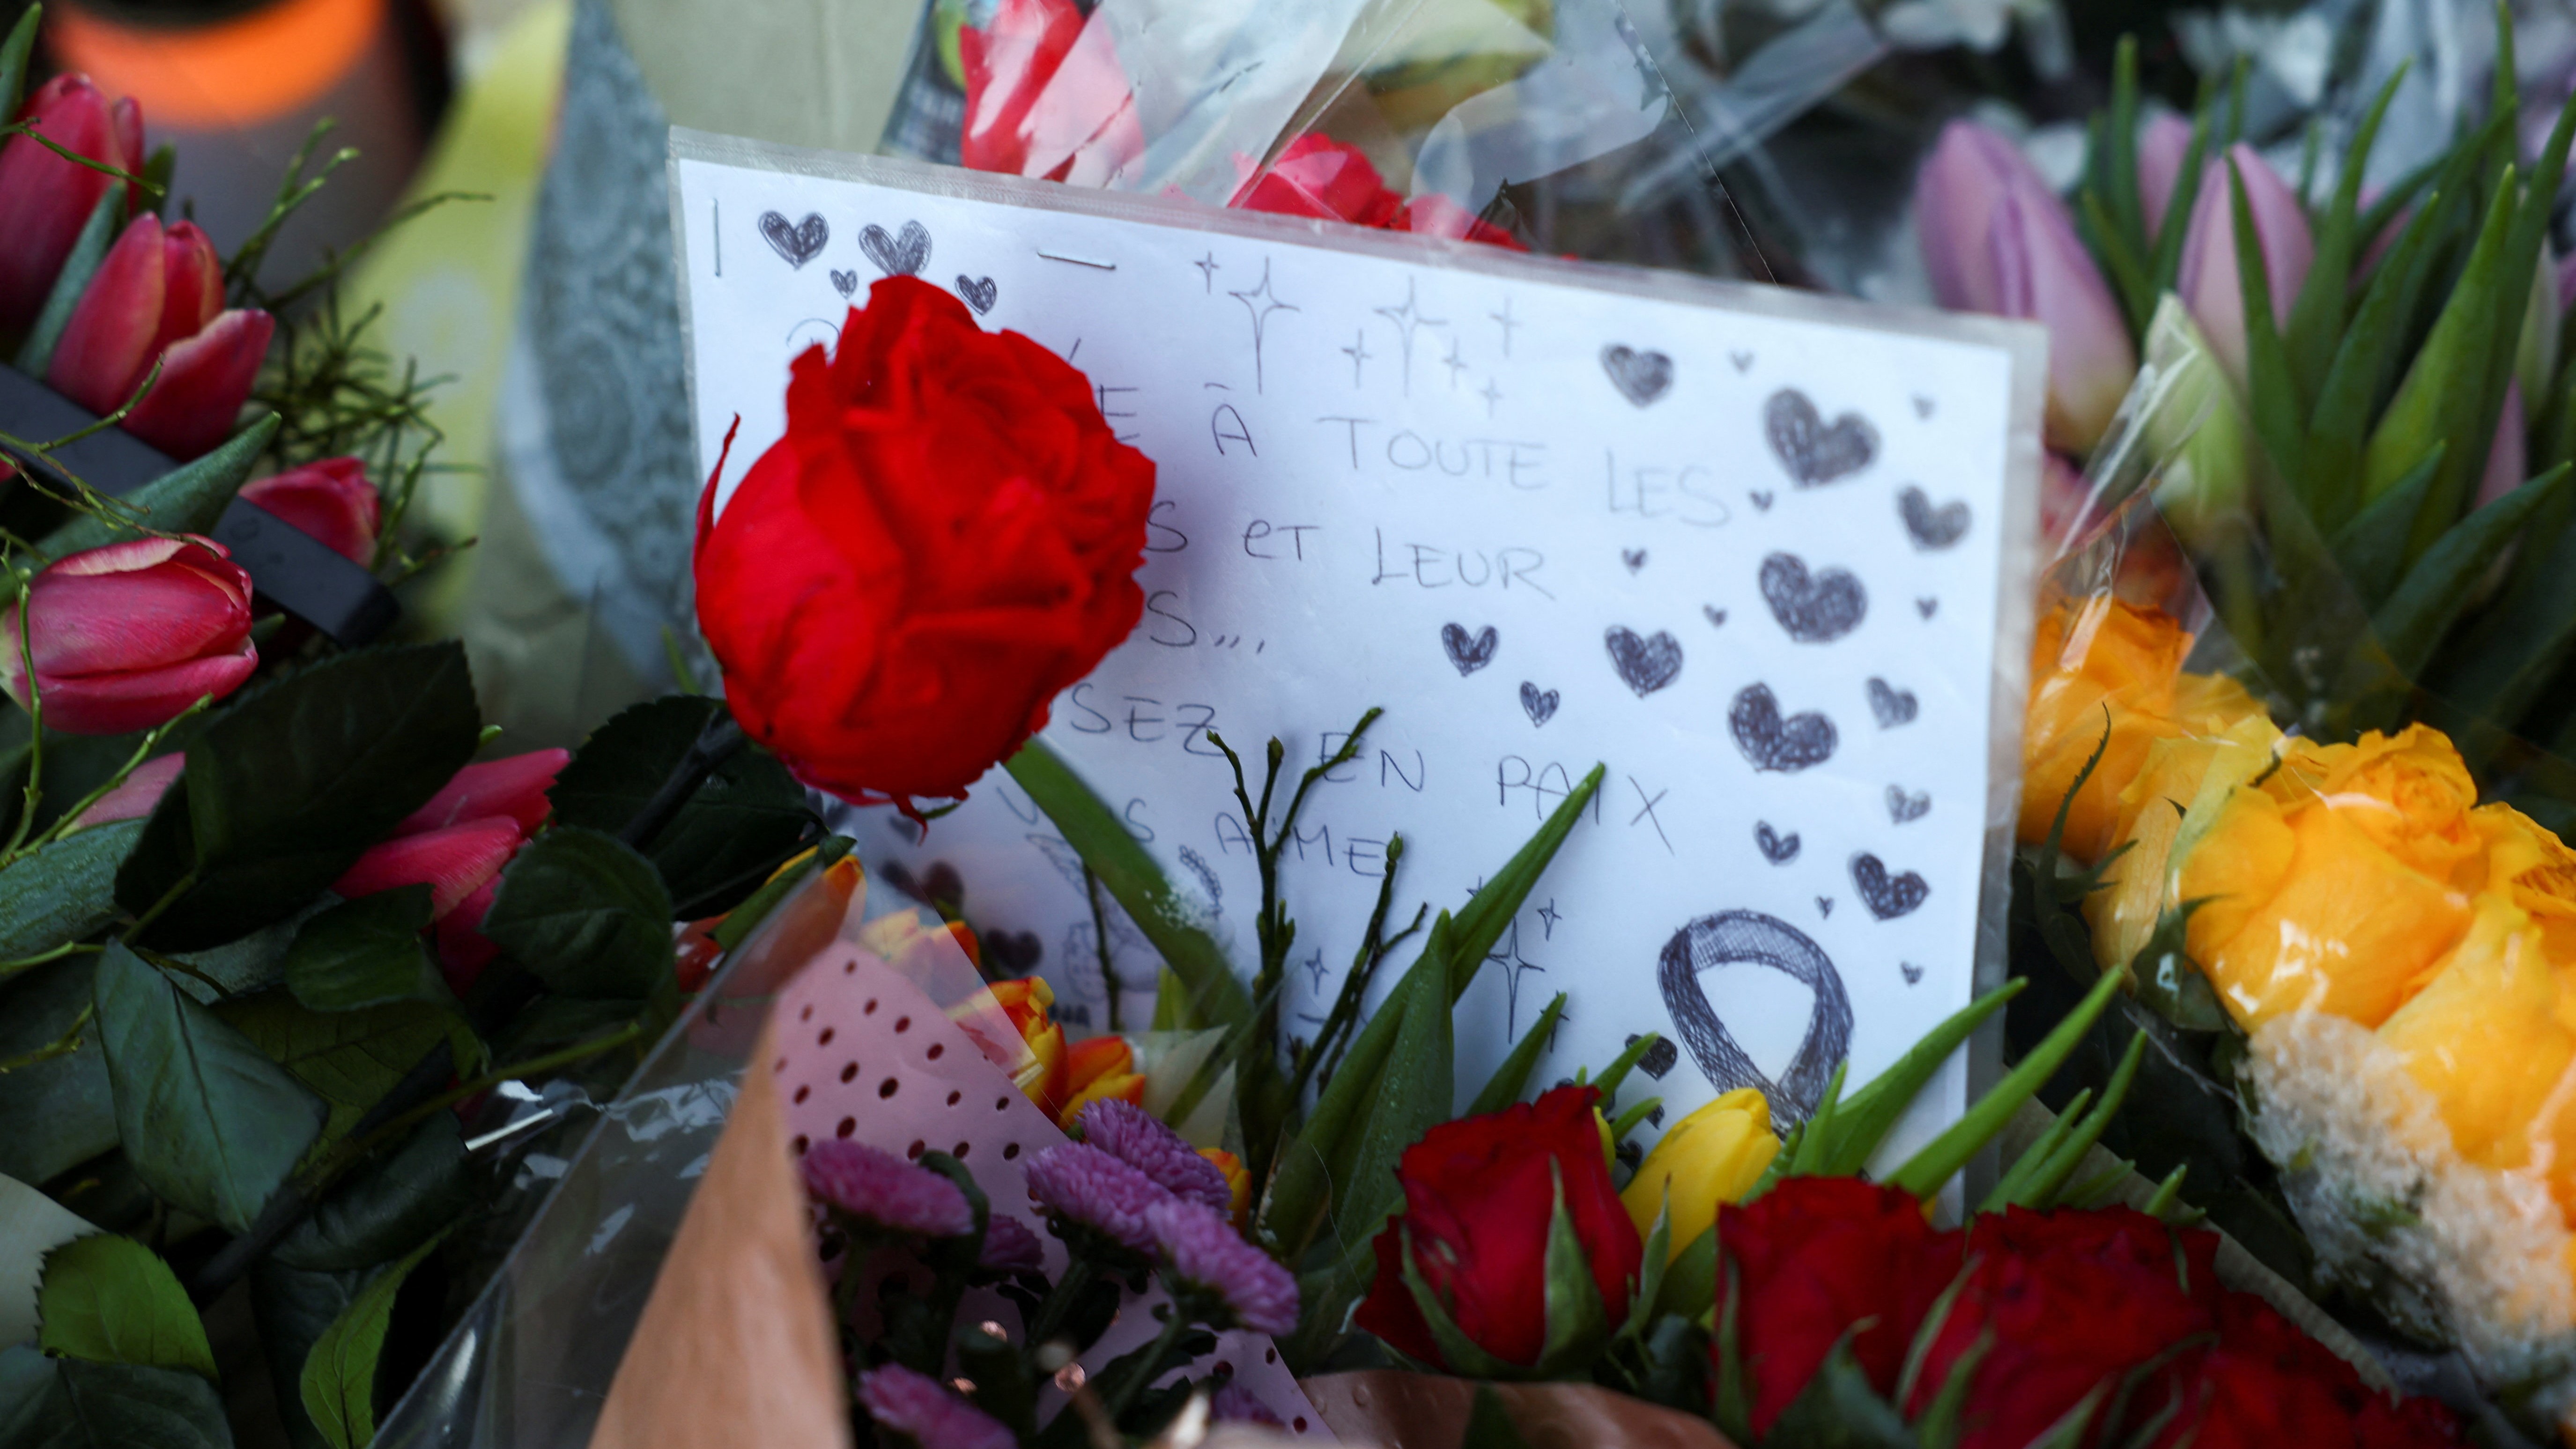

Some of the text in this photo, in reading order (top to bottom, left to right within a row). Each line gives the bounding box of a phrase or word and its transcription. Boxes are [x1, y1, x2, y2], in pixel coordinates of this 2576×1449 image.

[1315, 415, 1548, 490] TOUTE
[1606, 447, 1732, 528] LES
[1372, 526, 1556, 600] LEUR
[1318, 731, 1425, 792] EN
